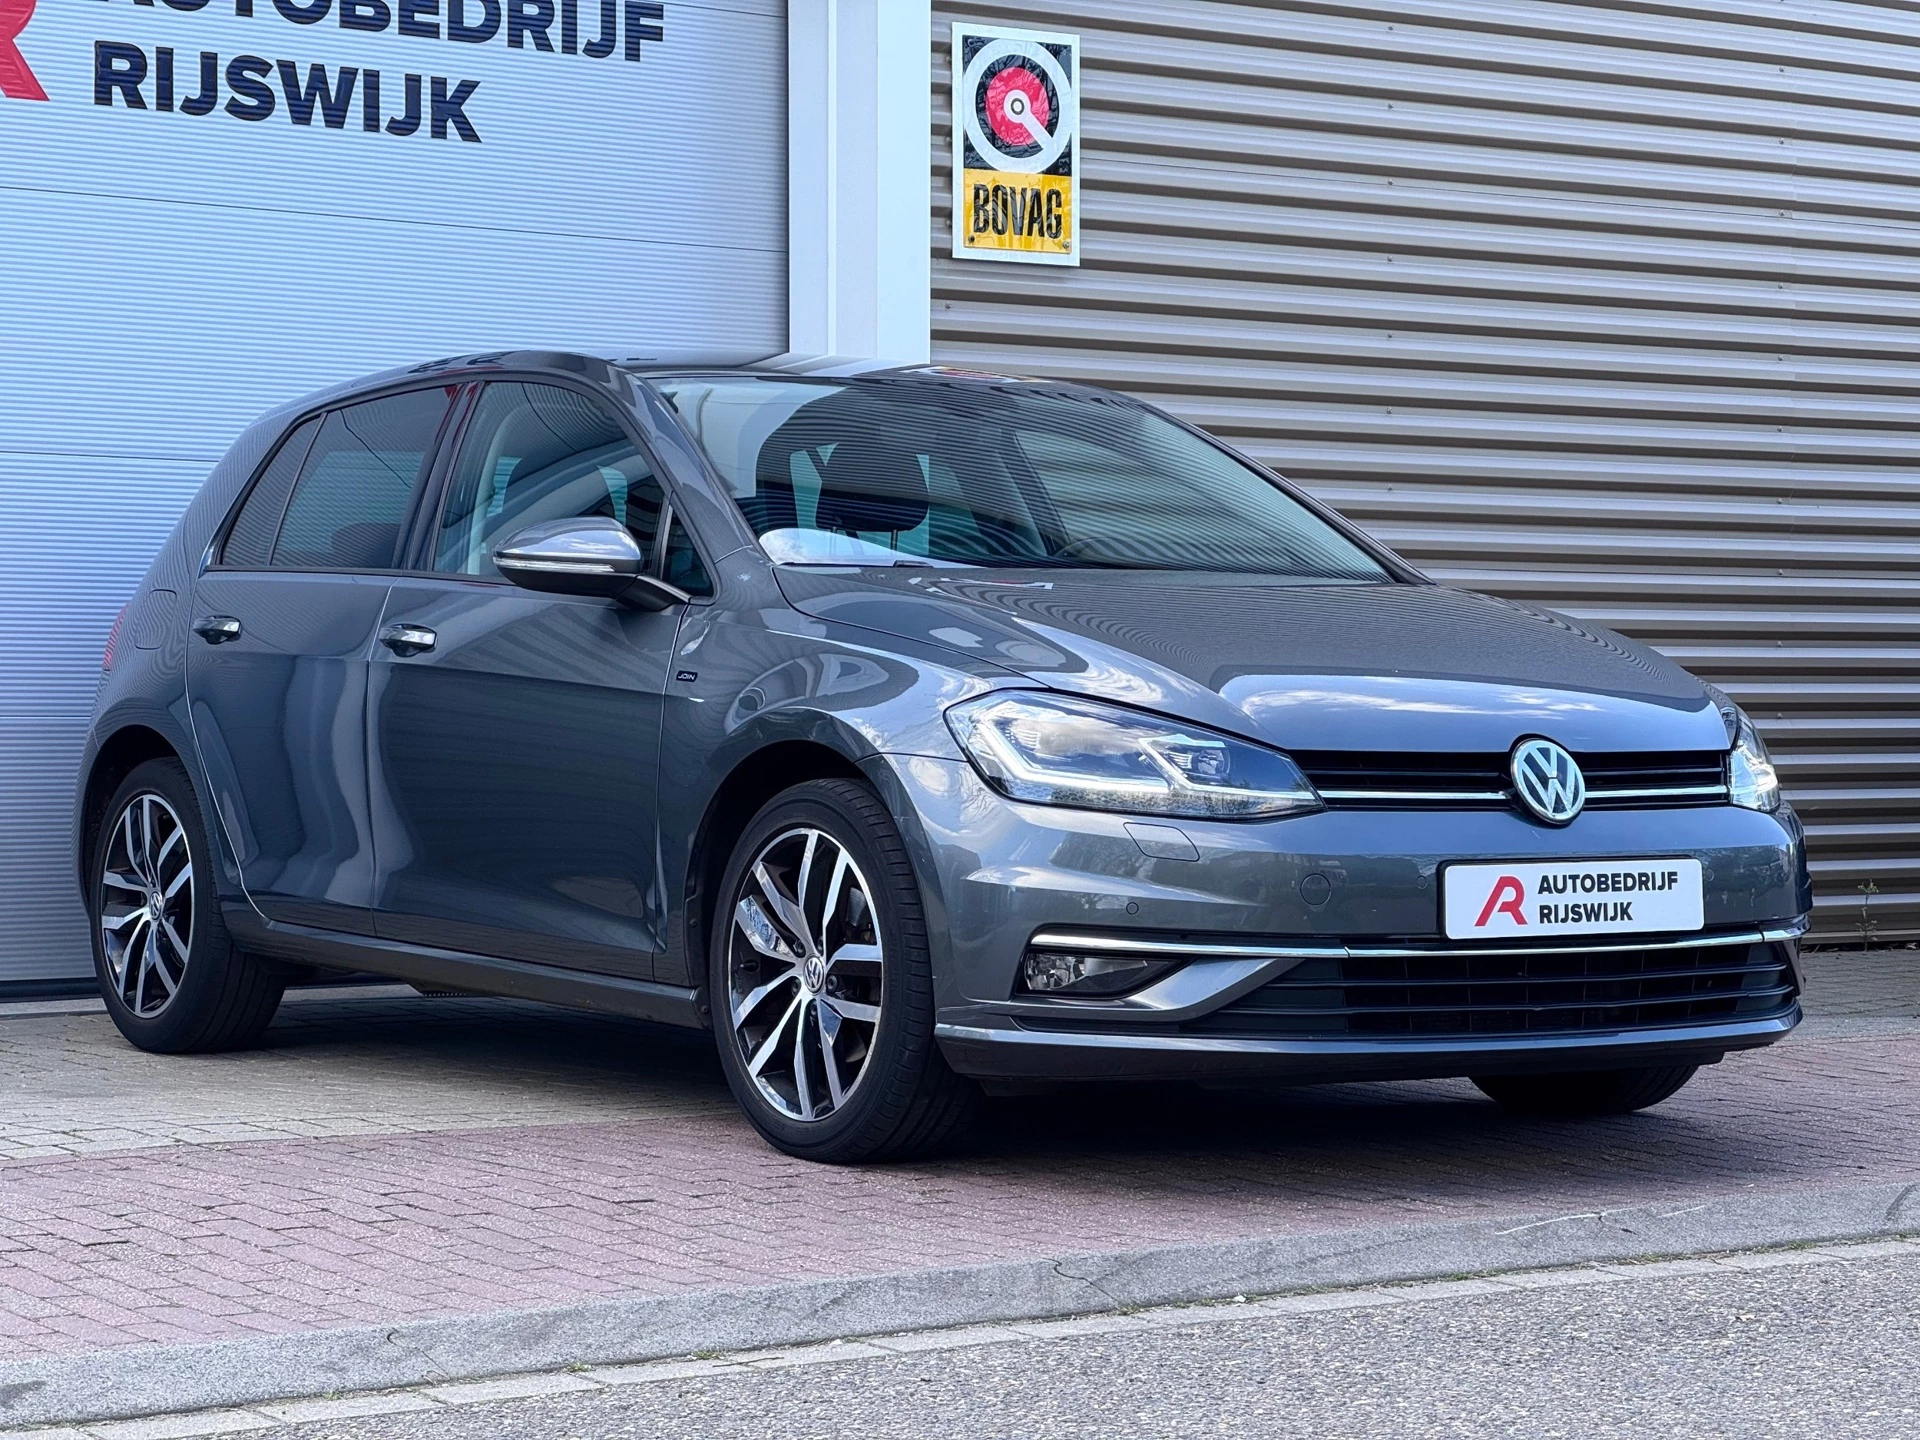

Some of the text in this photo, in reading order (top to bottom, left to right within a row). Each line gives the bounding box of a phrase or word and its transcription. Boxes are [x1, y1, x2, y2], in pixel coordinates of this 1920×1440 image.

[92, 0, 664, 62] BEDRIJF
[94, 40, 482, 143] RIJSWIJK
[973, 183, 1062, 239] BOVAG
[678, 673, 696, 681] JOIN
[1538, 871, 1678, 894] AUTOBEDRIJF
[1539, 902, 1633, 924] RIJSWIJK
